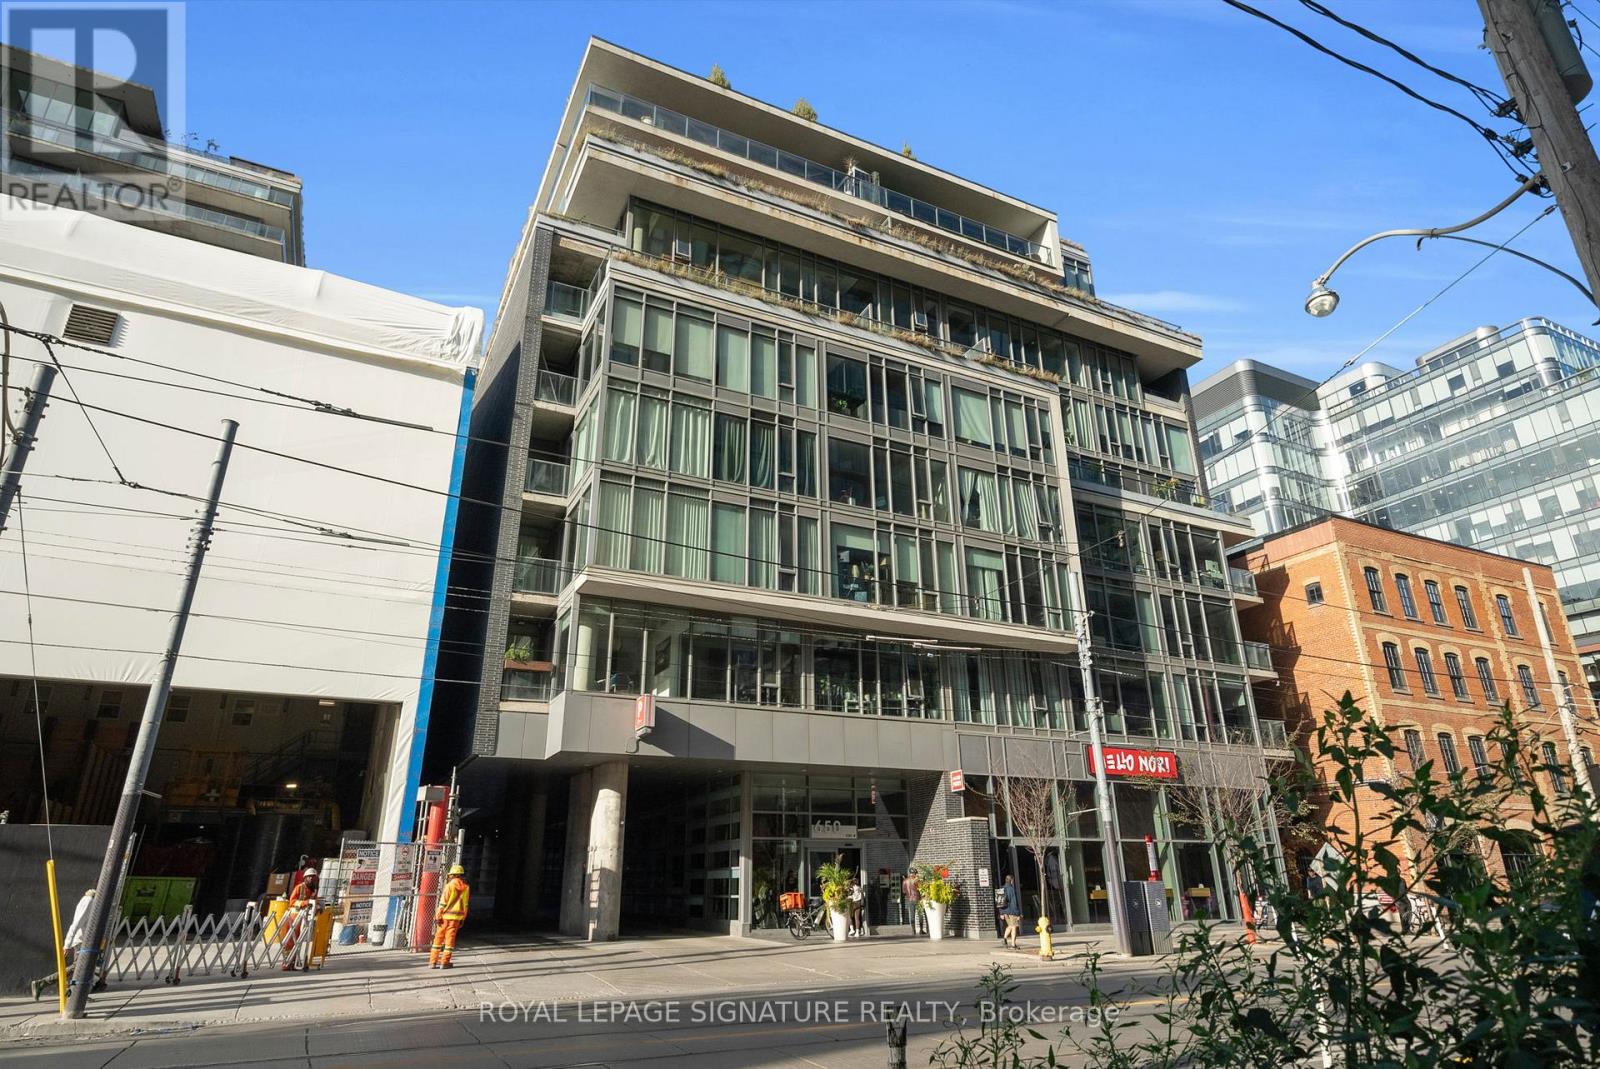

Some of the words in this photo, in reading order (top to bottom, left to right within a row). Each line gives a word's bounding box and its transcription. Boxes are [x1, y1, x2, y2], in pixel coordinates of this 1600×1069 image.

[1104, 752, 1135, 772] ELLO
[1138, 755, 1170, 773] NORI
[815, 820, 841, 832] 650
[359, 849, 379, 857] NOTICE
[352, 872, 375, 880] DANGER
